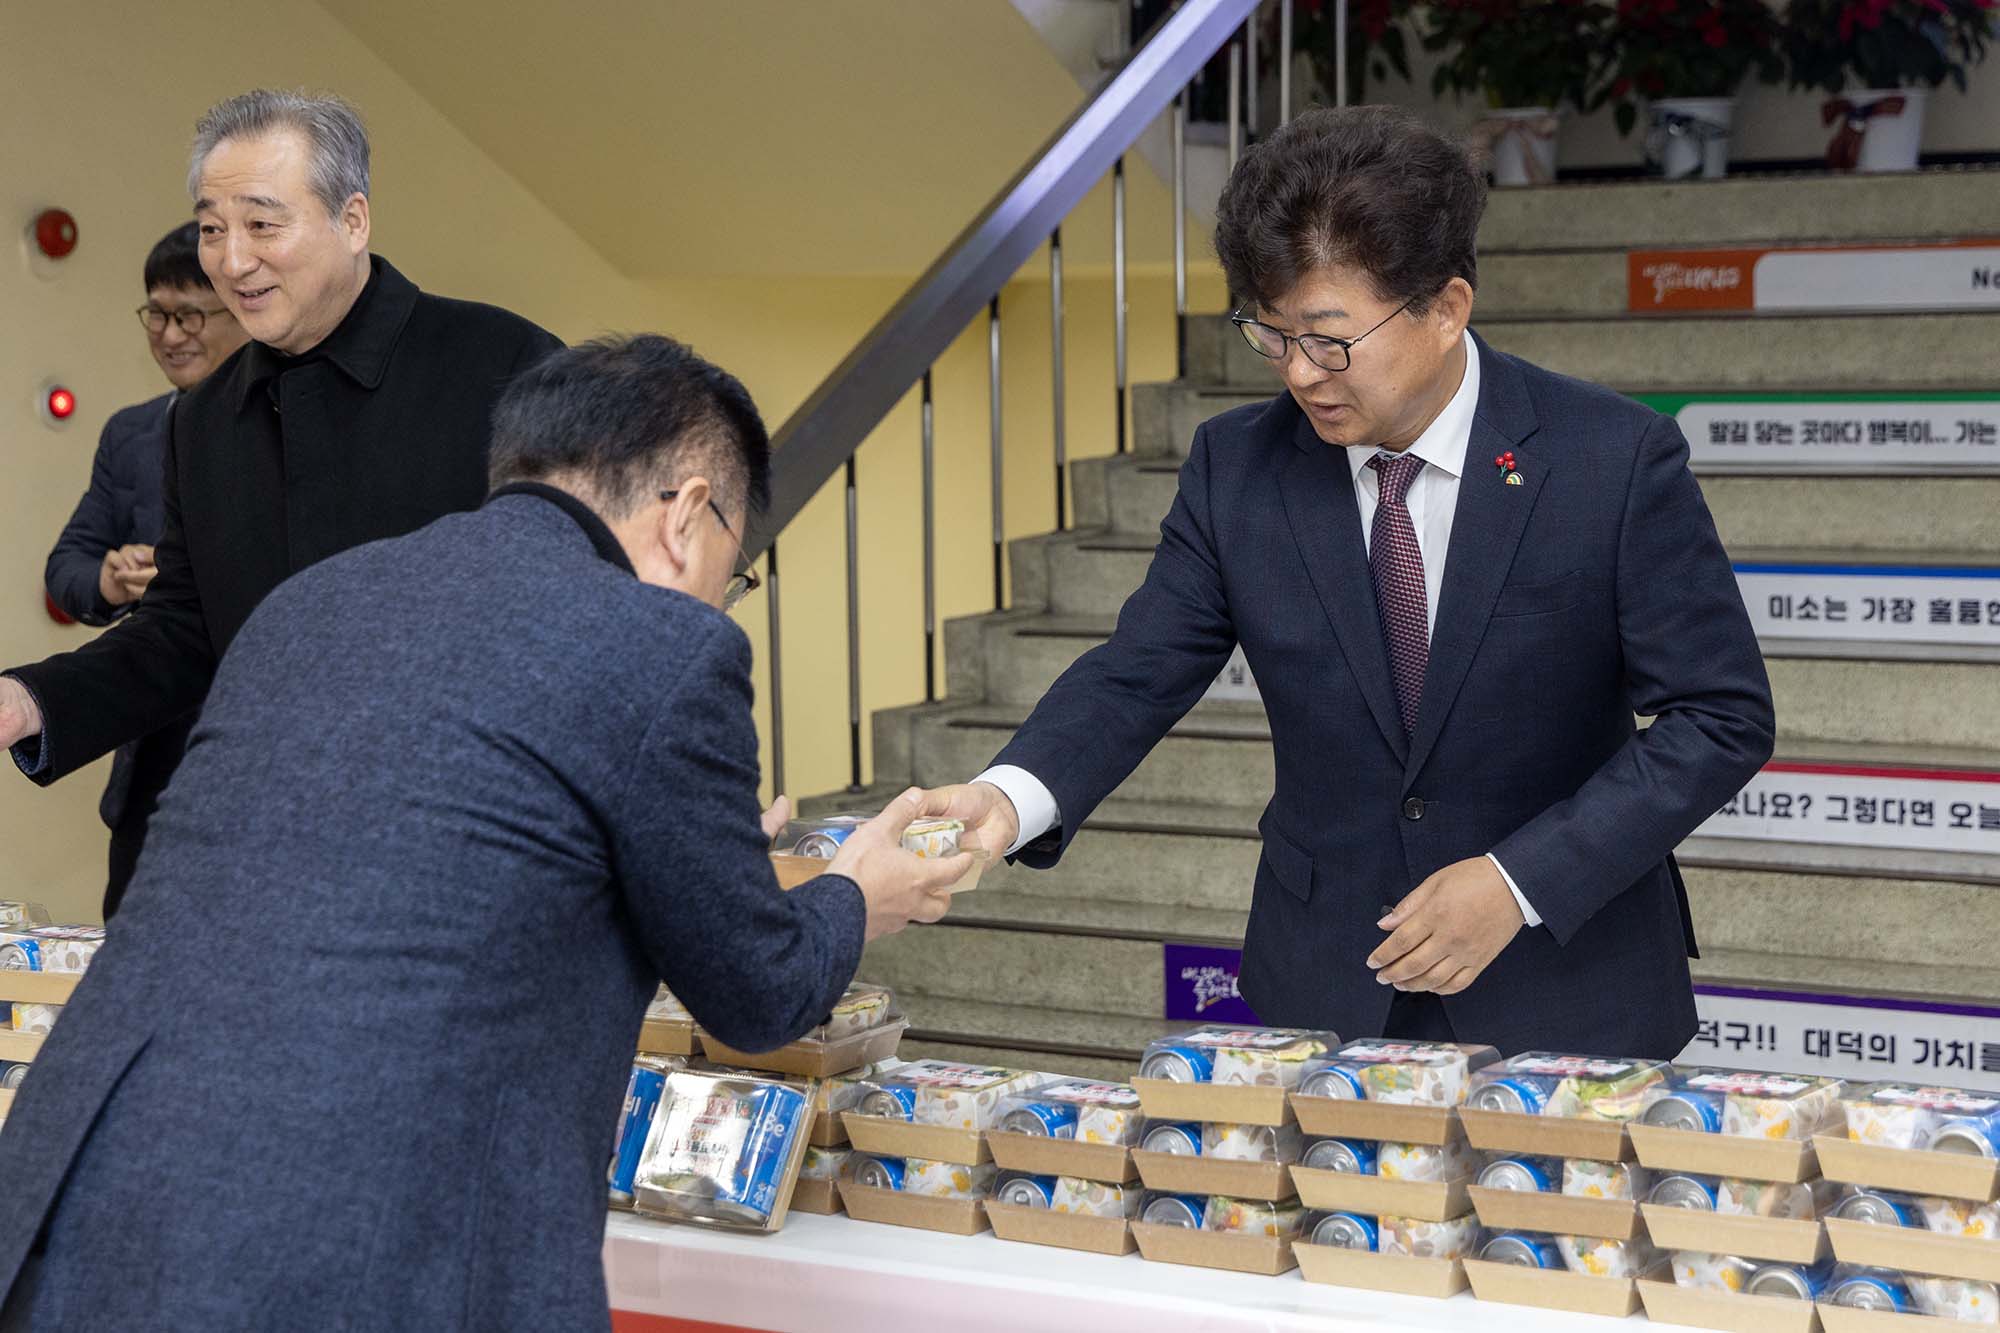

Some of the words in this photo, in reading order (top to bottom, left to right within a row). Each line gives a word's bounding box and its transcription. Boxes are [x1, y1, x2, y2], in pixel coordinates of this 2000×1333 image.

[1708, 420, 1749, 445] 발길
[1800, 420, 1862, 445] 곳마다
[1955, 420, 1997, 445] 가는
[1768, 594, 1849, 621] 미소는
[1862, 596, 1915, 624] 가장
[1825, 795, 1935, 827] 그렇다면
[1948, 801, 2000, 830] 오늘
[1803, 1028, 1896, 1064] 대덕의
